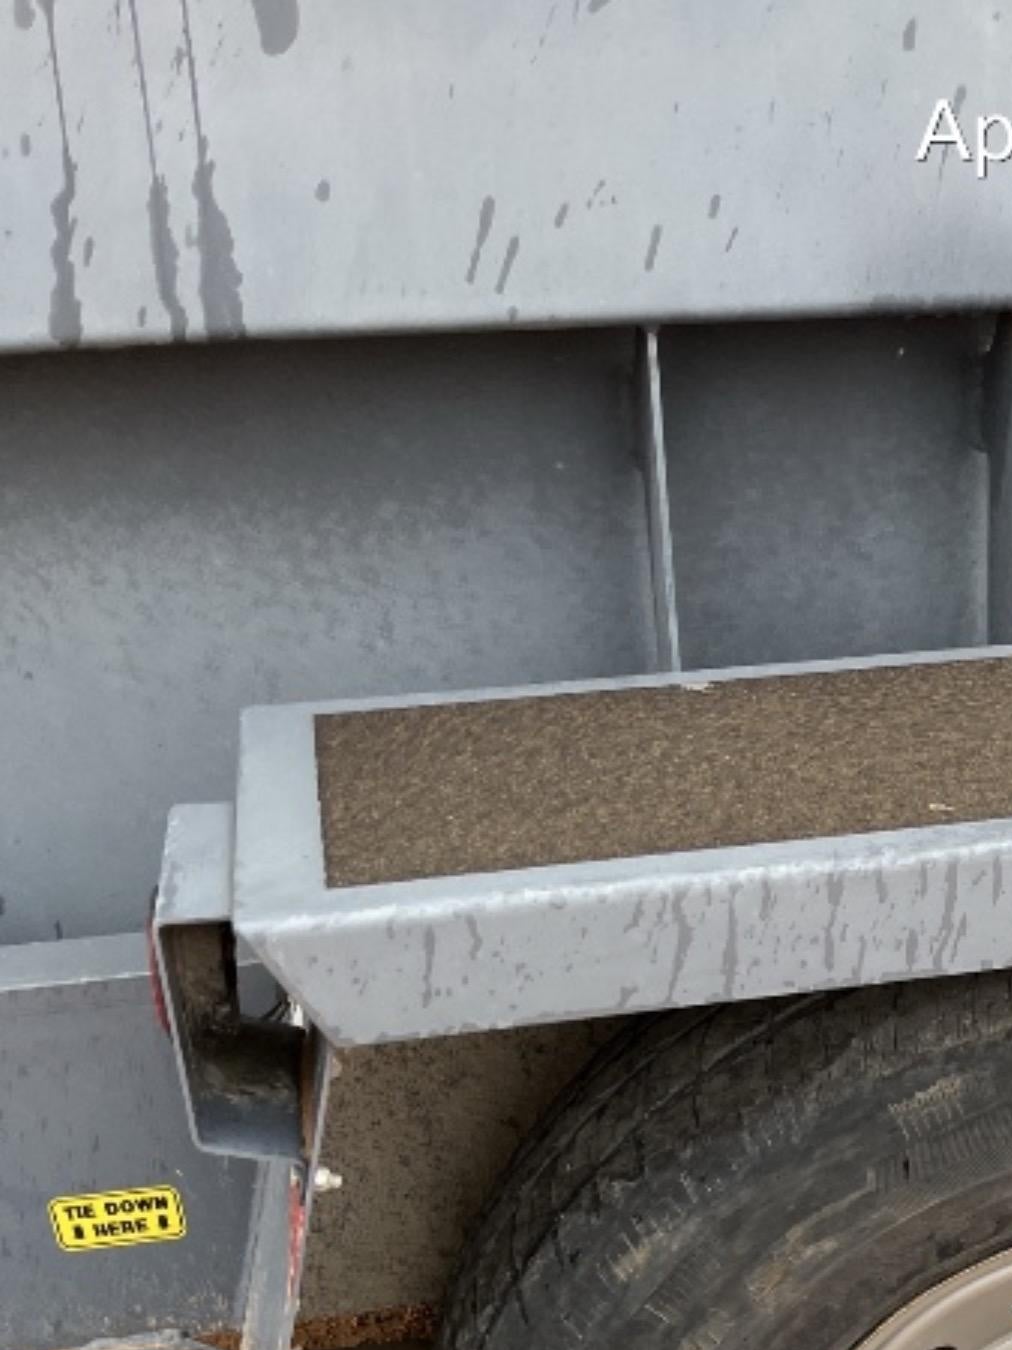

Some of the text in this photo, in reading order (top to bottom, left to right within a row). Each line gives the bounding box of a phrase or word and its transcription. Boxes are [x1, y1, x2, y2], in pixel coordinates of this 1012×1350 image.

[64, 1196, 168, 1220] TIE DOWN
[92, 1218, 150, 1237] HERE
